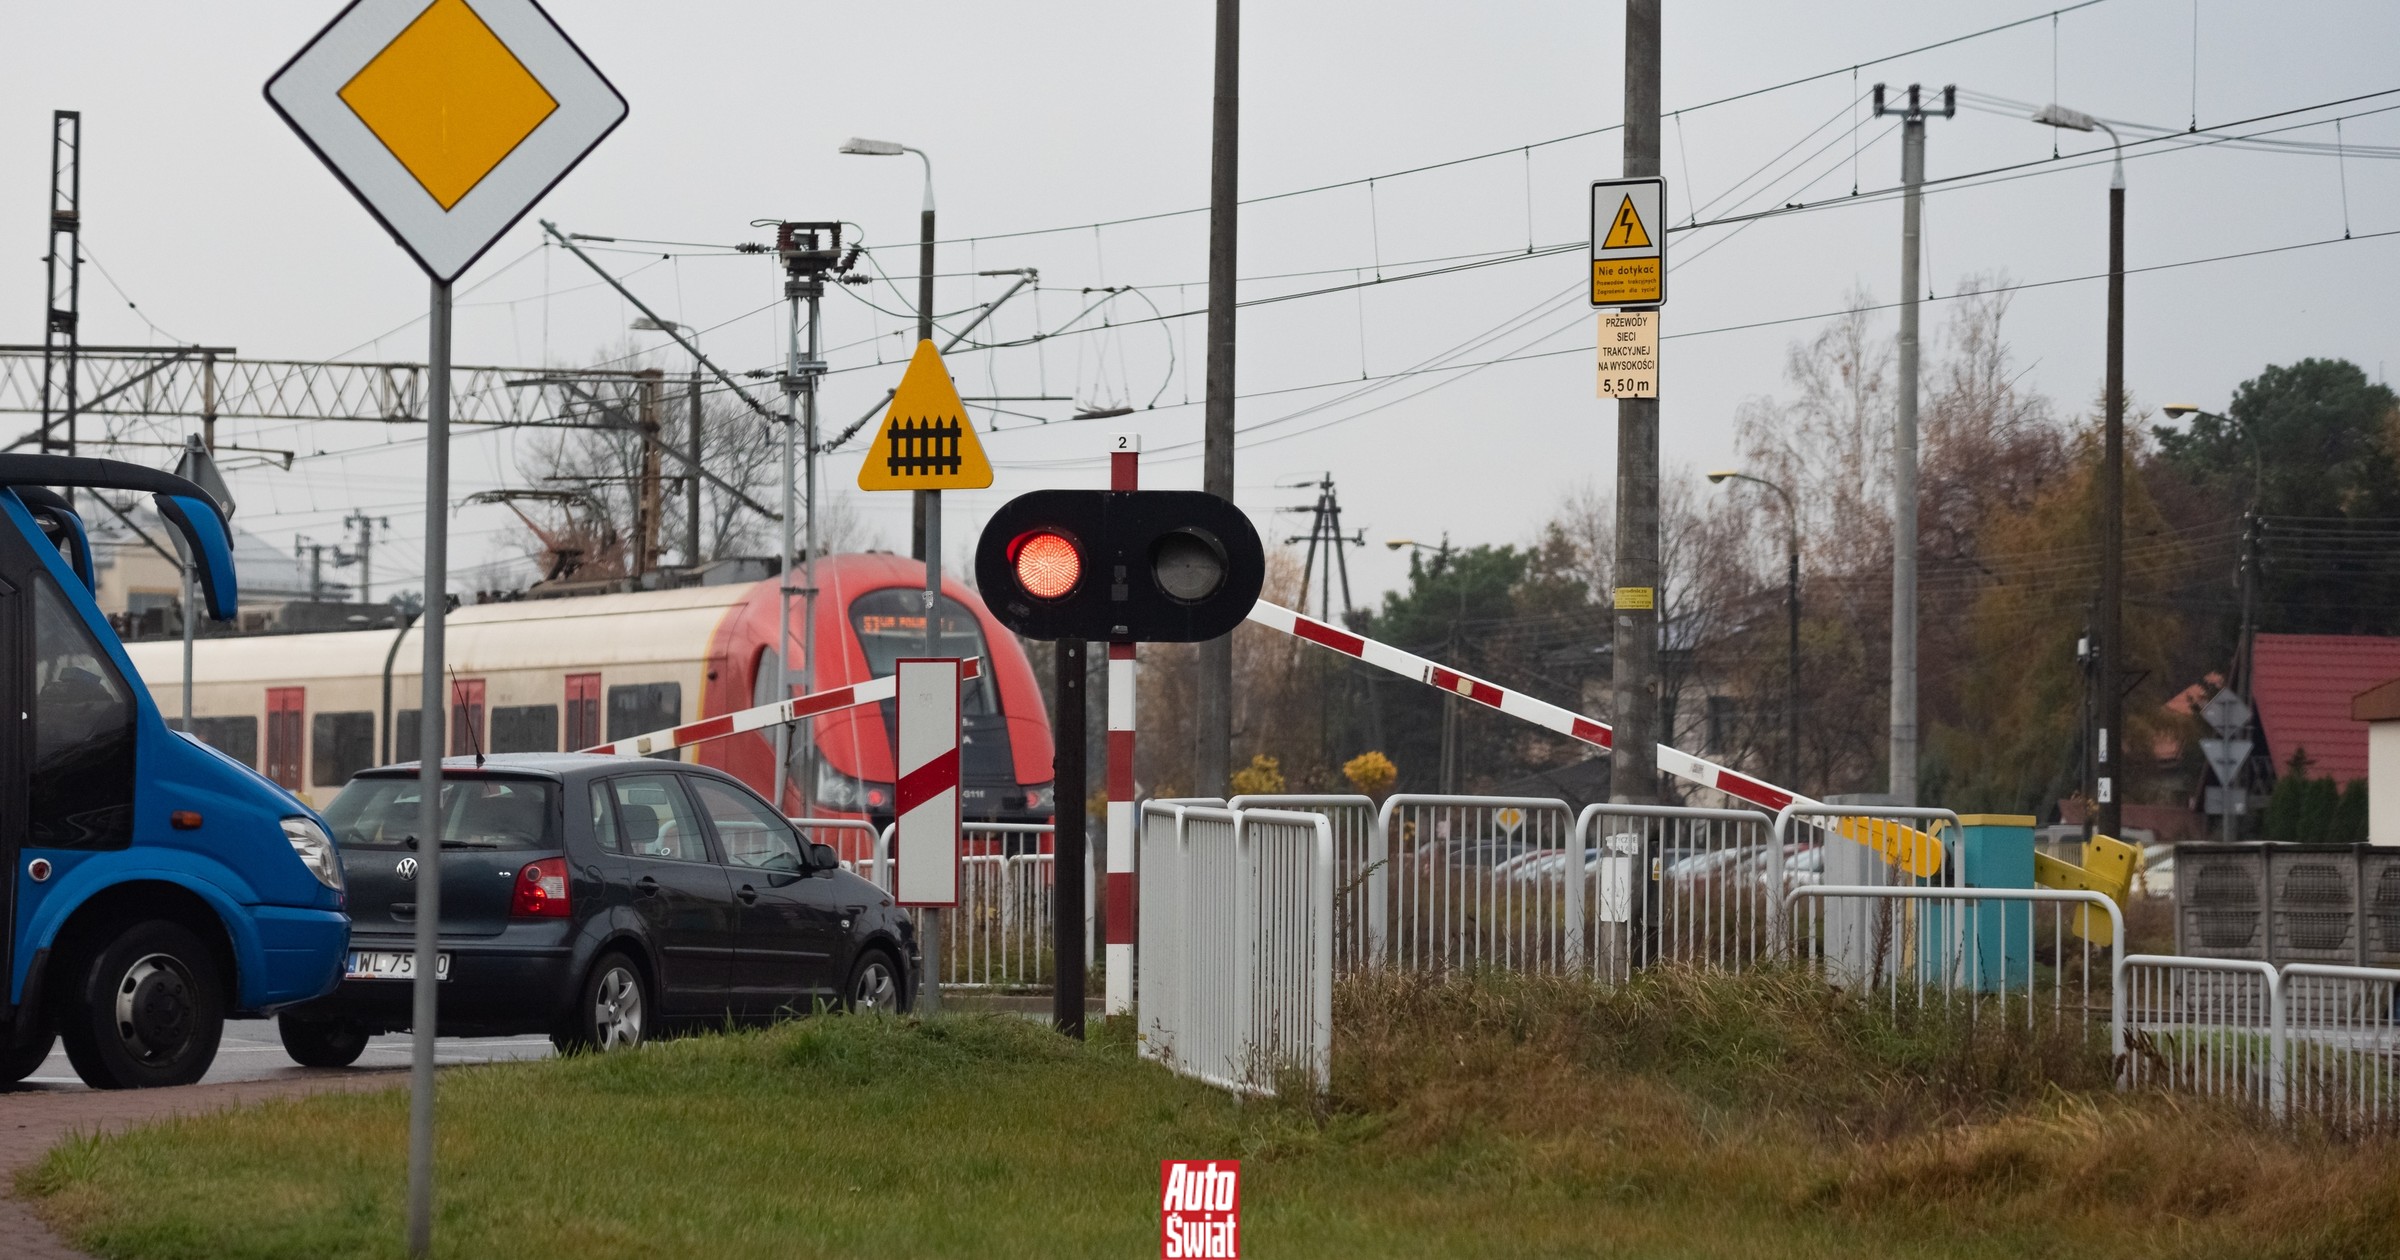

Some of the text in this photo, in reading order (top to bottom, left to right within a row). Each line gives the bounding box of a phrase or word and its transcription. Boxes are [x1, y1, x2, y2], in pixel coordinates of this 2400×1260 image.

[1598, 264, 1654, 276] Nie dotykać
[1605, 317, 1648, 327] PRZEWODY
[1616, 332, 1636, 342] SIECI
[1602, 345, 1651, 356] TRAKCYJNEJ
[1598, 359, 1655, 371] NA WYSOKOŚCI
[1637, 380, 1649, 391] m
[1118, 436, 1127, 449] 2
[359, 953, 447, 974] WL 750
